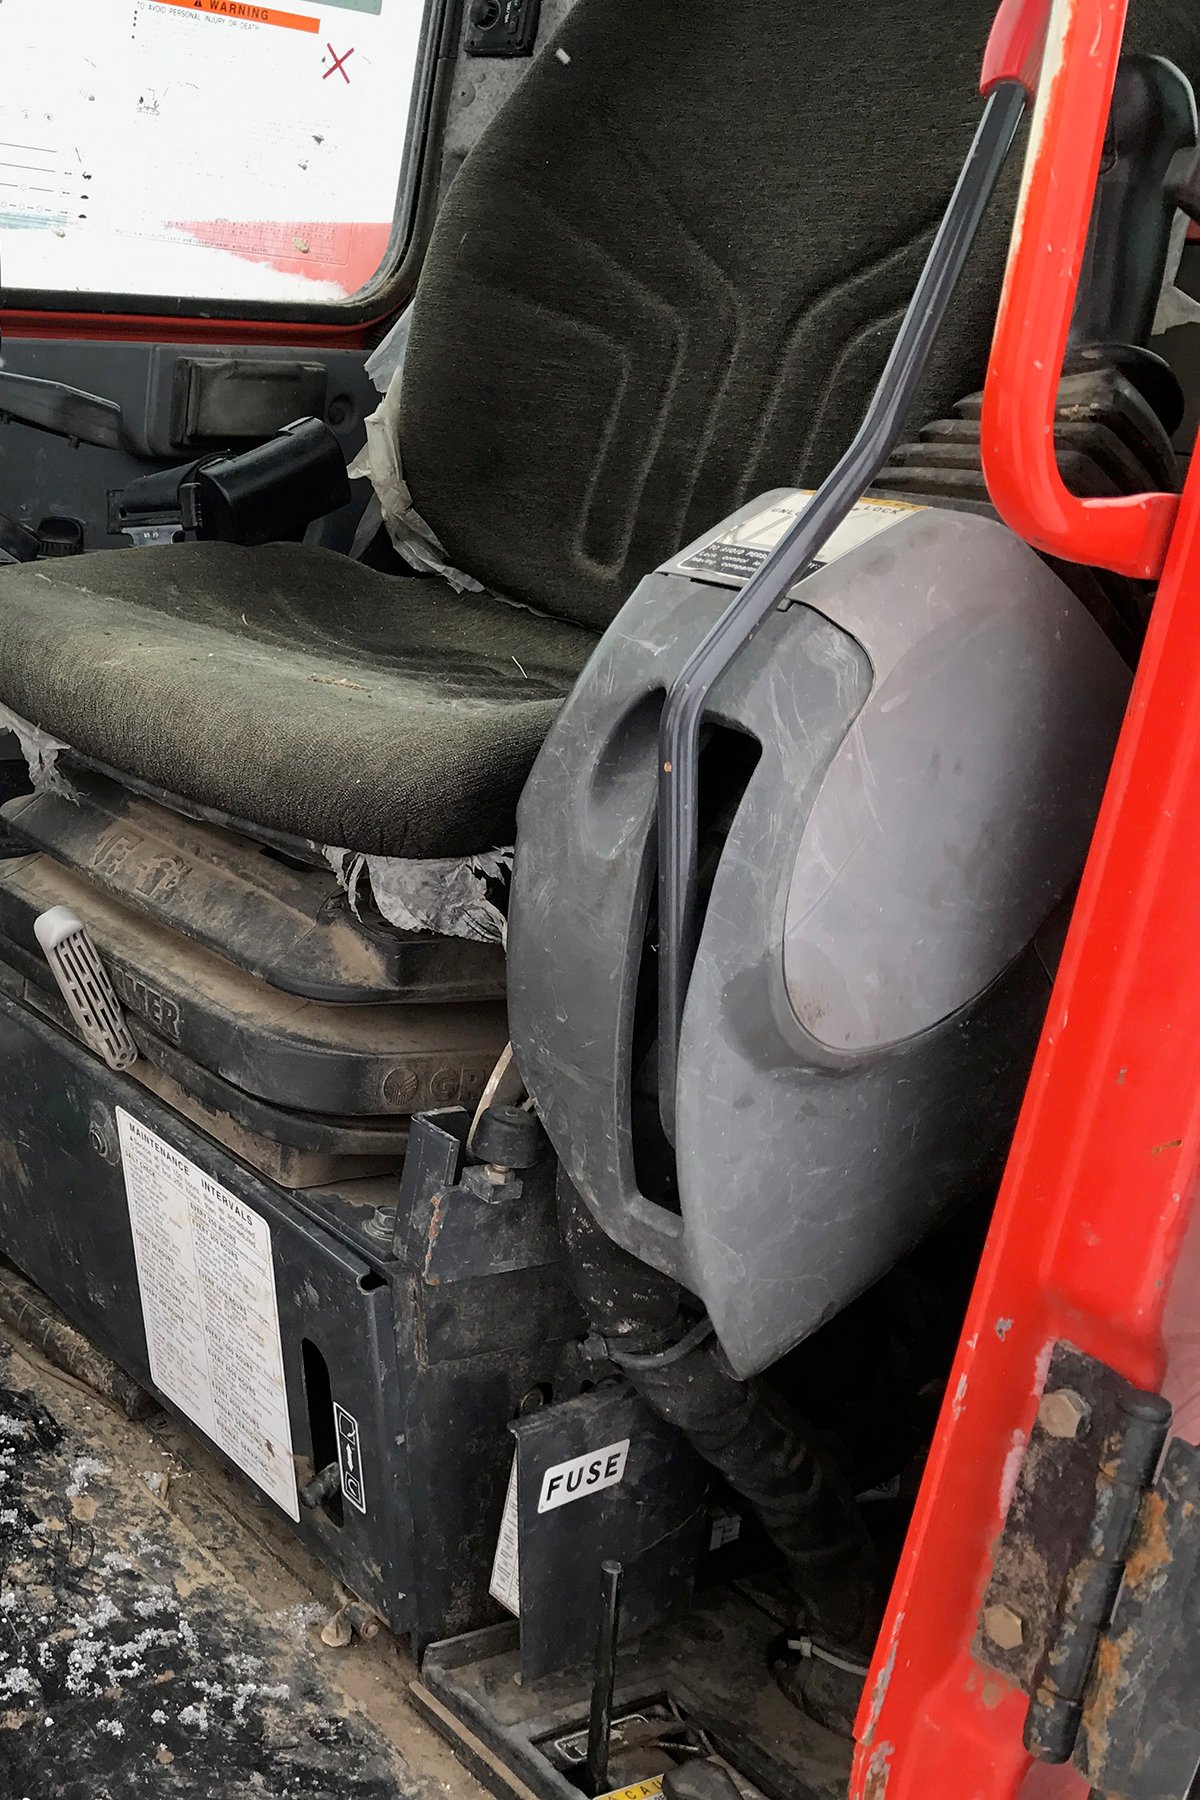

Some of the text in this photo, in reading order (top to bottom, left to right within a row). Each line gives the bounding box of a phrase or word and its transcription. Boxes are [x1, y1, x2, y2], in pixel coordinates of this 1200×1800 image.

[136, 1, 145, 10] TO
[148, 3, 166, 14] AVOID
[168, 7, 201, 21] PERSONAL
[204, 15, 226, 25] INJURY
[209, 0, 269, 21] WARNING
[771, 506, 800, 516] UNLO
[864, 505, 904, 515] LOCK
[128, 1120, 190, 1177] MAINTENANCE
[200, 1177, 253, 1228] INTERVALS
[546, 1452, 622, 1502] FUSE
